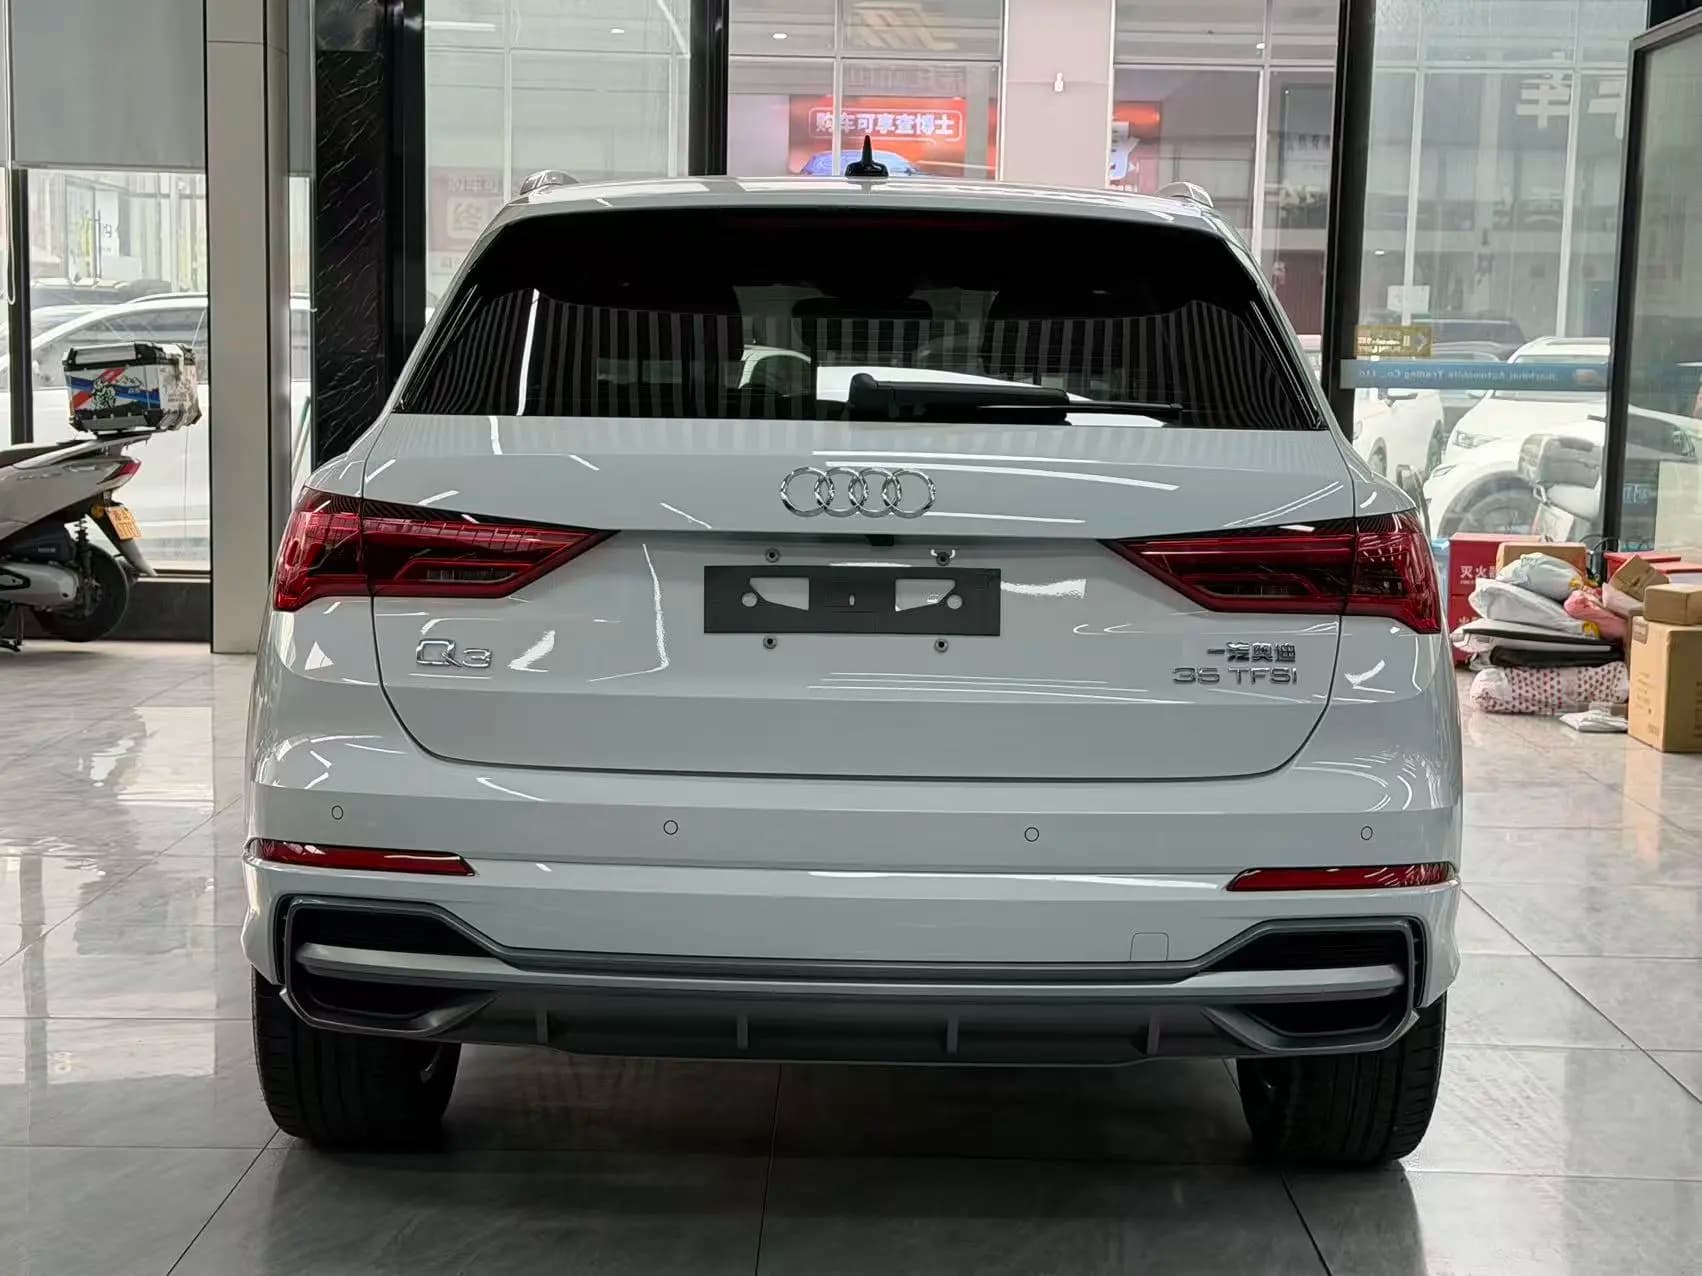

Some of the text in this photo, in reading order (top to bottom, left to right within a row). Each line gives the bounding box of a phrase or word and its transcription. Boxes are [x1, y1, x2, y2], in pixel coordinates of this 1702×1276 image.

[416, 638, 492, 668] Q3
[1207, 642, 1296, 662] 一汽奥迪
[1173, 667, 1297, 685] 35 TFSI
